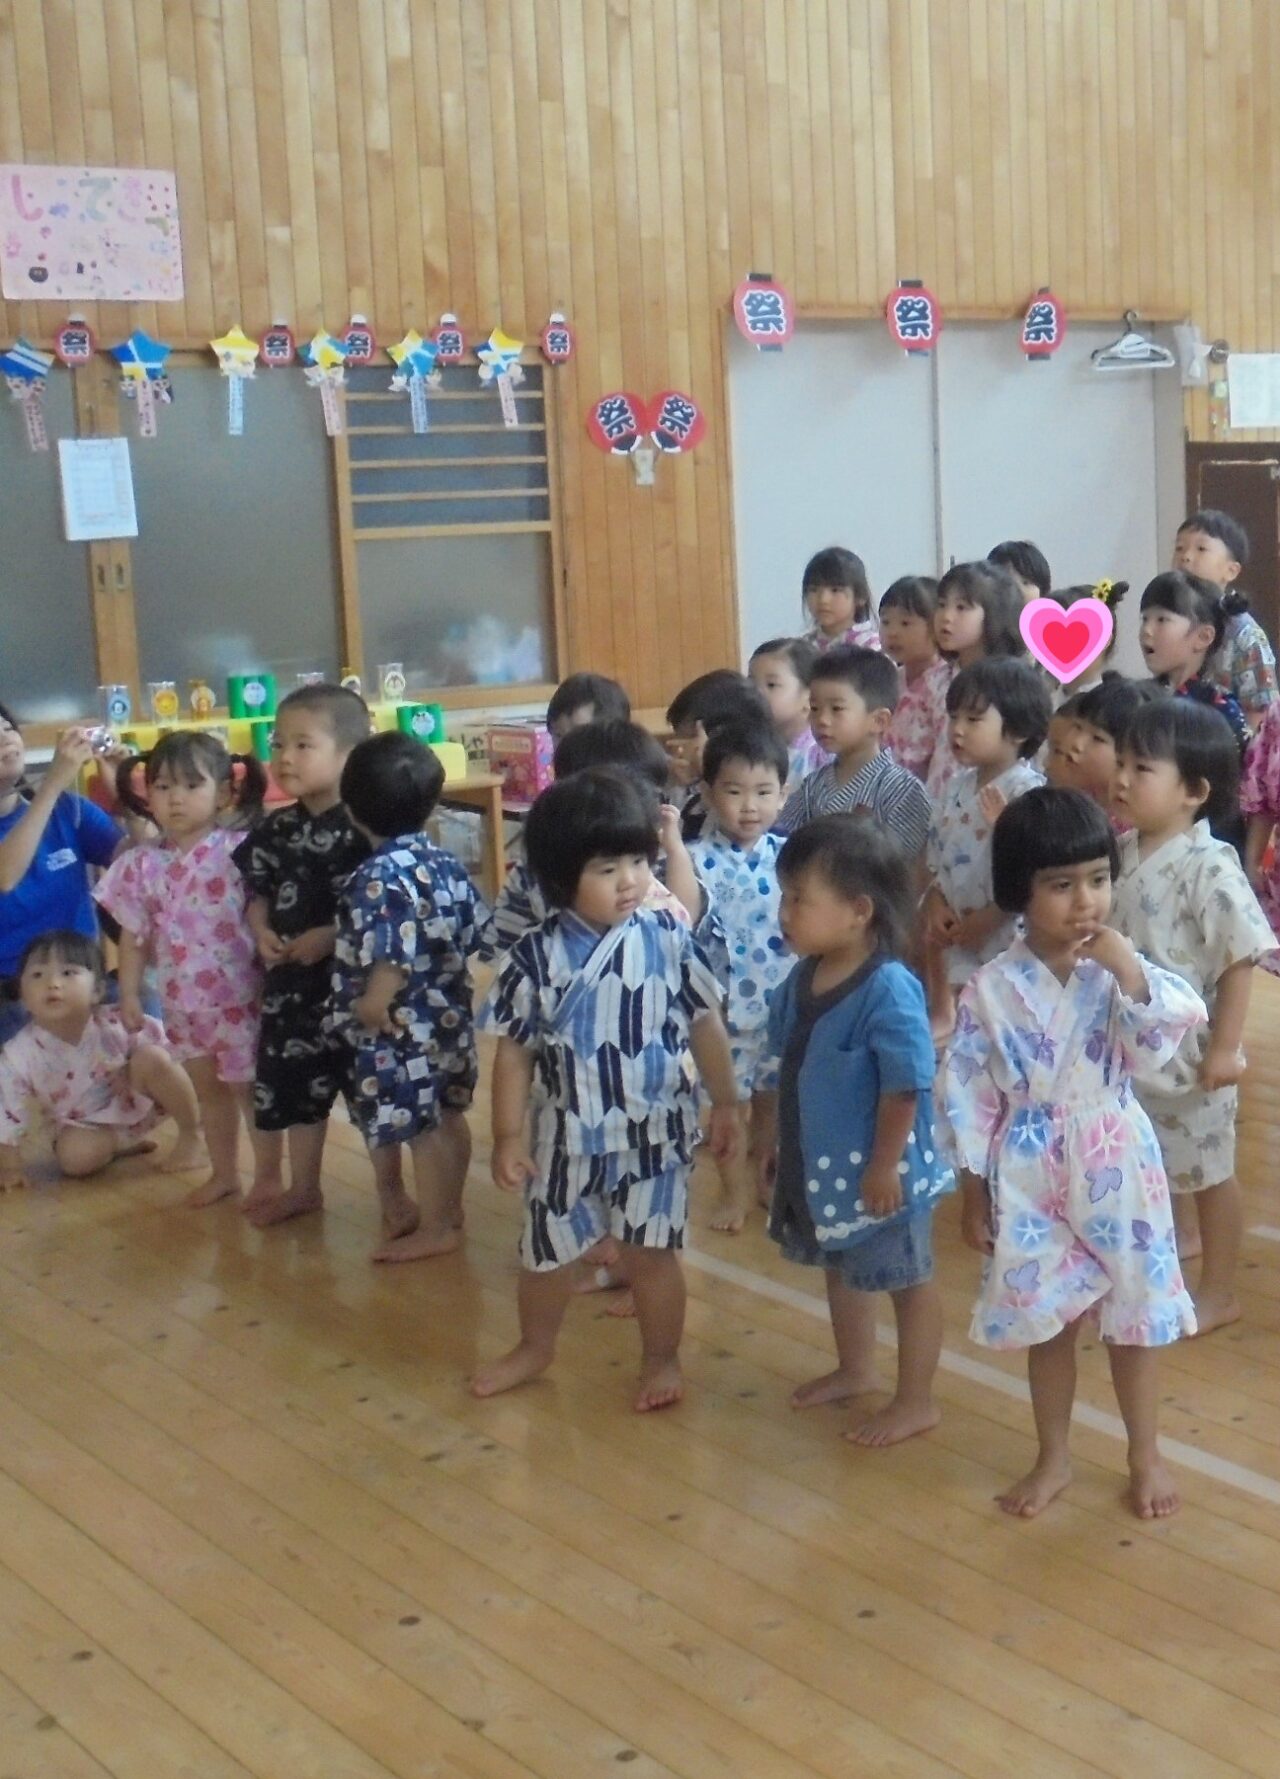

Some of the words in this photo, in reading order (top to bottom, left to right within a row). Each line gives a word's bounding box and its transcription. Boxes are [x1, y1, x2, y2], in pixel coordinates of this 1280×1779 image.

[742, 291, 785, 334] 祭
[894, 297, 931, 338] 祭
[1023, 302, 1056, 343] 祭
[62, 331, 88, 355] 祭
[264, 333, 288, 355] 祭
[347, 332, 370, 355] 祭
[438, 332, 461, 355] 祭
[548, 330, 569, 354] 祭
[597, 396, 635, 440] 祭
[658, 395, 695, 440] 祭
